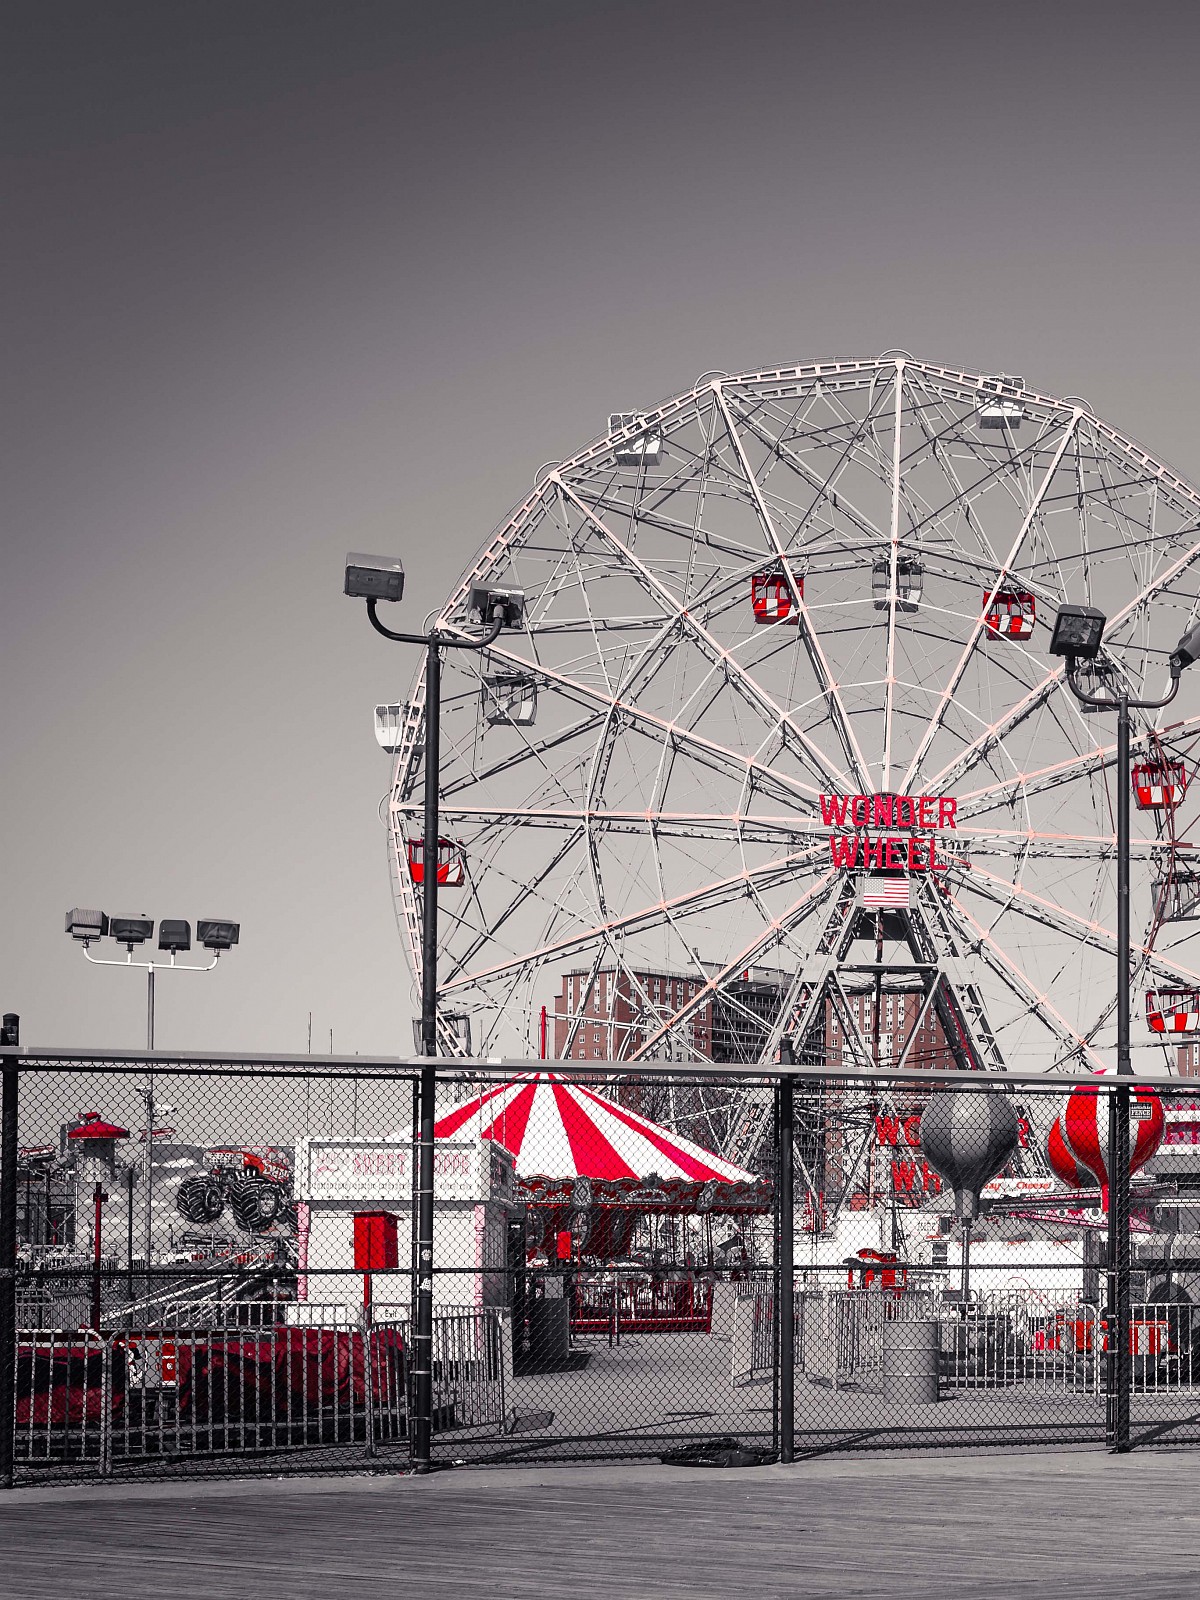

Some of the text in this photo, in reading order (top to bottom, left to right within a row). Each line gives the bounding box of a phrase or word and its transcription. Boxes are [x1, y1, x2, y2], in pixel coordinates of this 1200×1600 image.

[819, 794, 957, 829] WONDER
[829, 835, 948, 871] WHEEL
[385, 1309, 397, 1318] Exit
